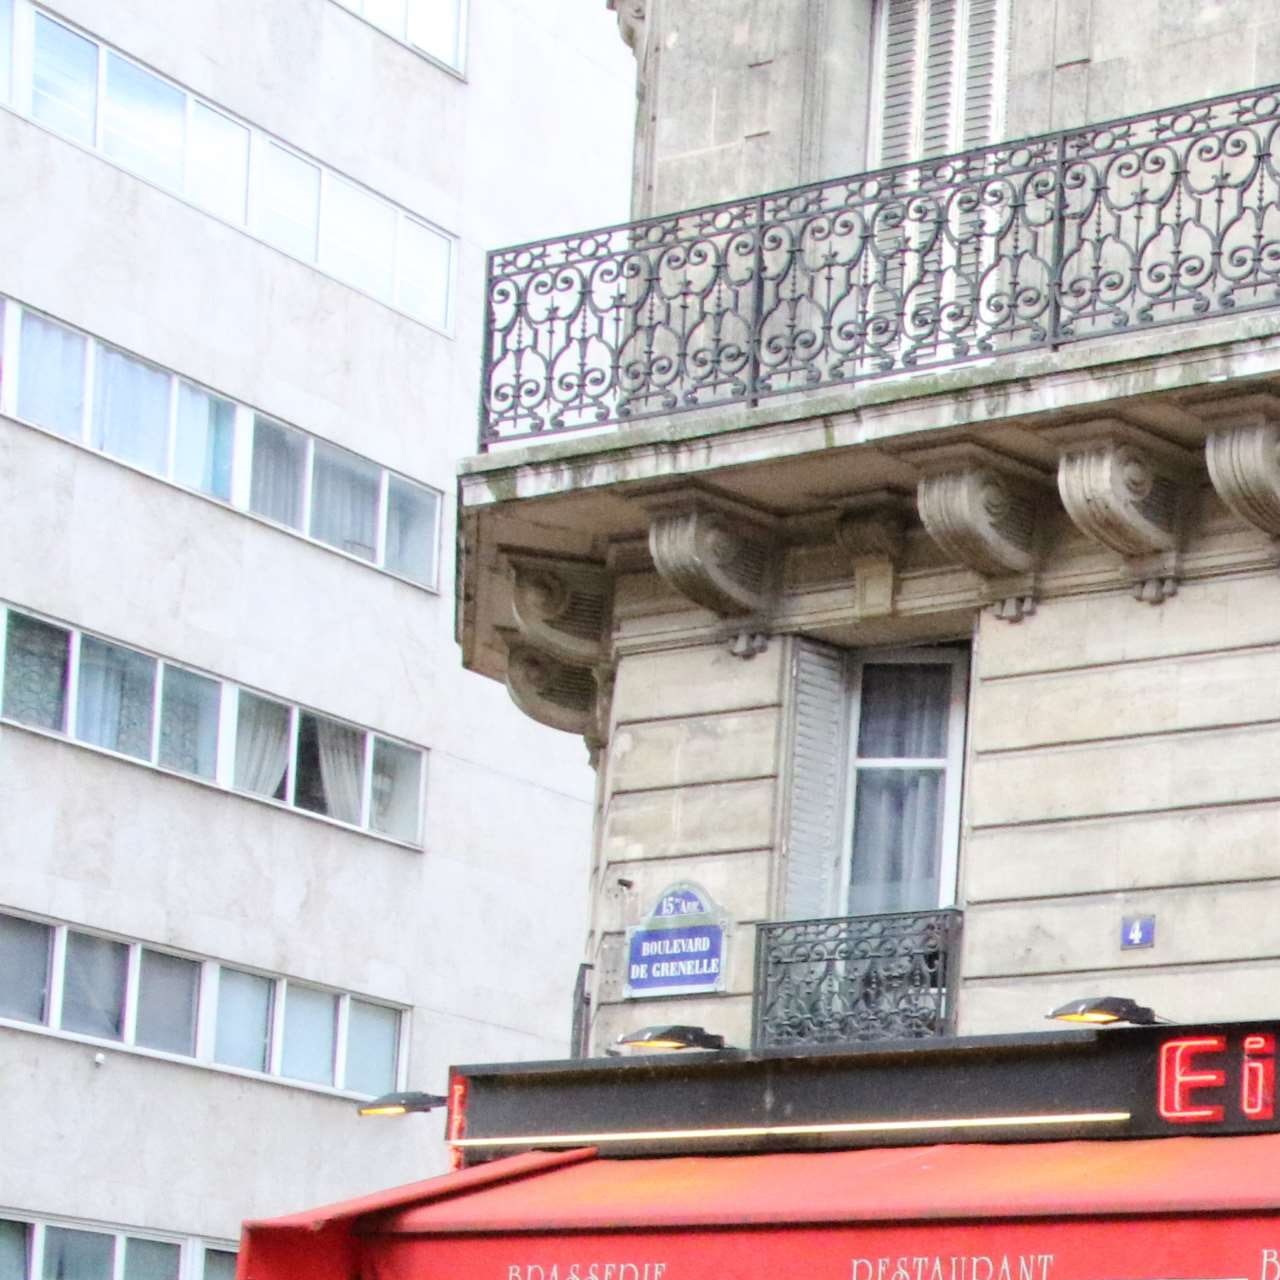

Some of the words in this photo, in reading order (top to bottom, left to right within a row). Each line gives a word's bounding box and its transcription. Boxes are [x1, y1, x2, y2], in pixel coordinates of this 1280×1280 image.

[1128, 919, 1143, 944] 4
[641, 937, 711, 957] BOULEVARD
[630, 963, 648, 979] DE
[652, 958, 719, 977] GRENELLE
